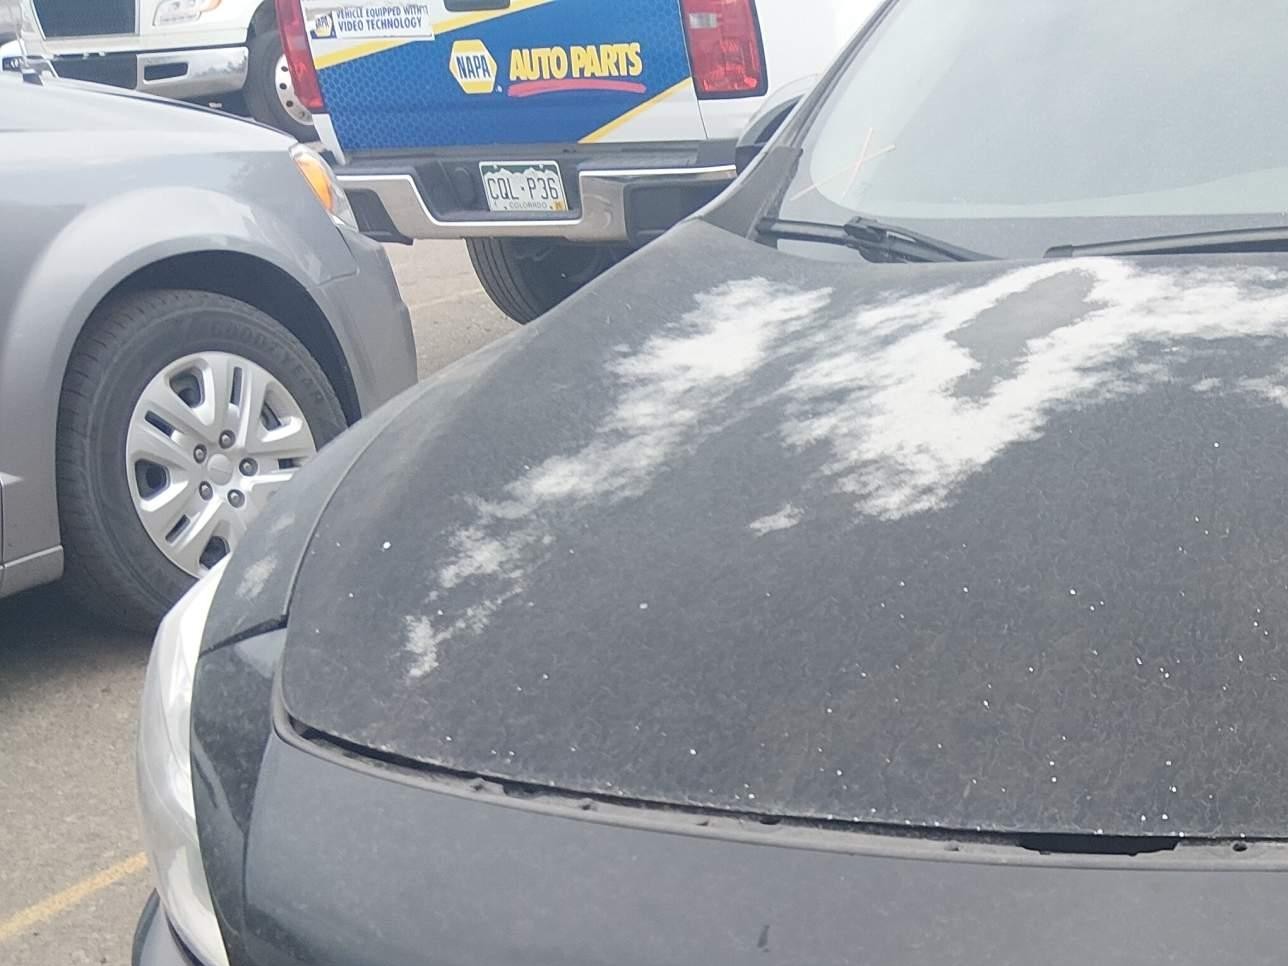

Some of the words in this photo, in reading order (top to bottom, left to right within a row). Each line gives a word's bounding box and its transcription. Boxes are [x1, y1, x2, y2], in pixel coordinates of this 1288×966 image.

[366, 6, 401, 18] EQUIPPED
[338, 19, 364, 32] VIDEO
[366, 16, 422, 30] TECHNOLOGY
[456, 54, 491, 80] NAPA
[510, 46, 568, 81] AUTO
[570, 42, 643, 79] PARTS
[509, 200, 548, 209] COLORADO
